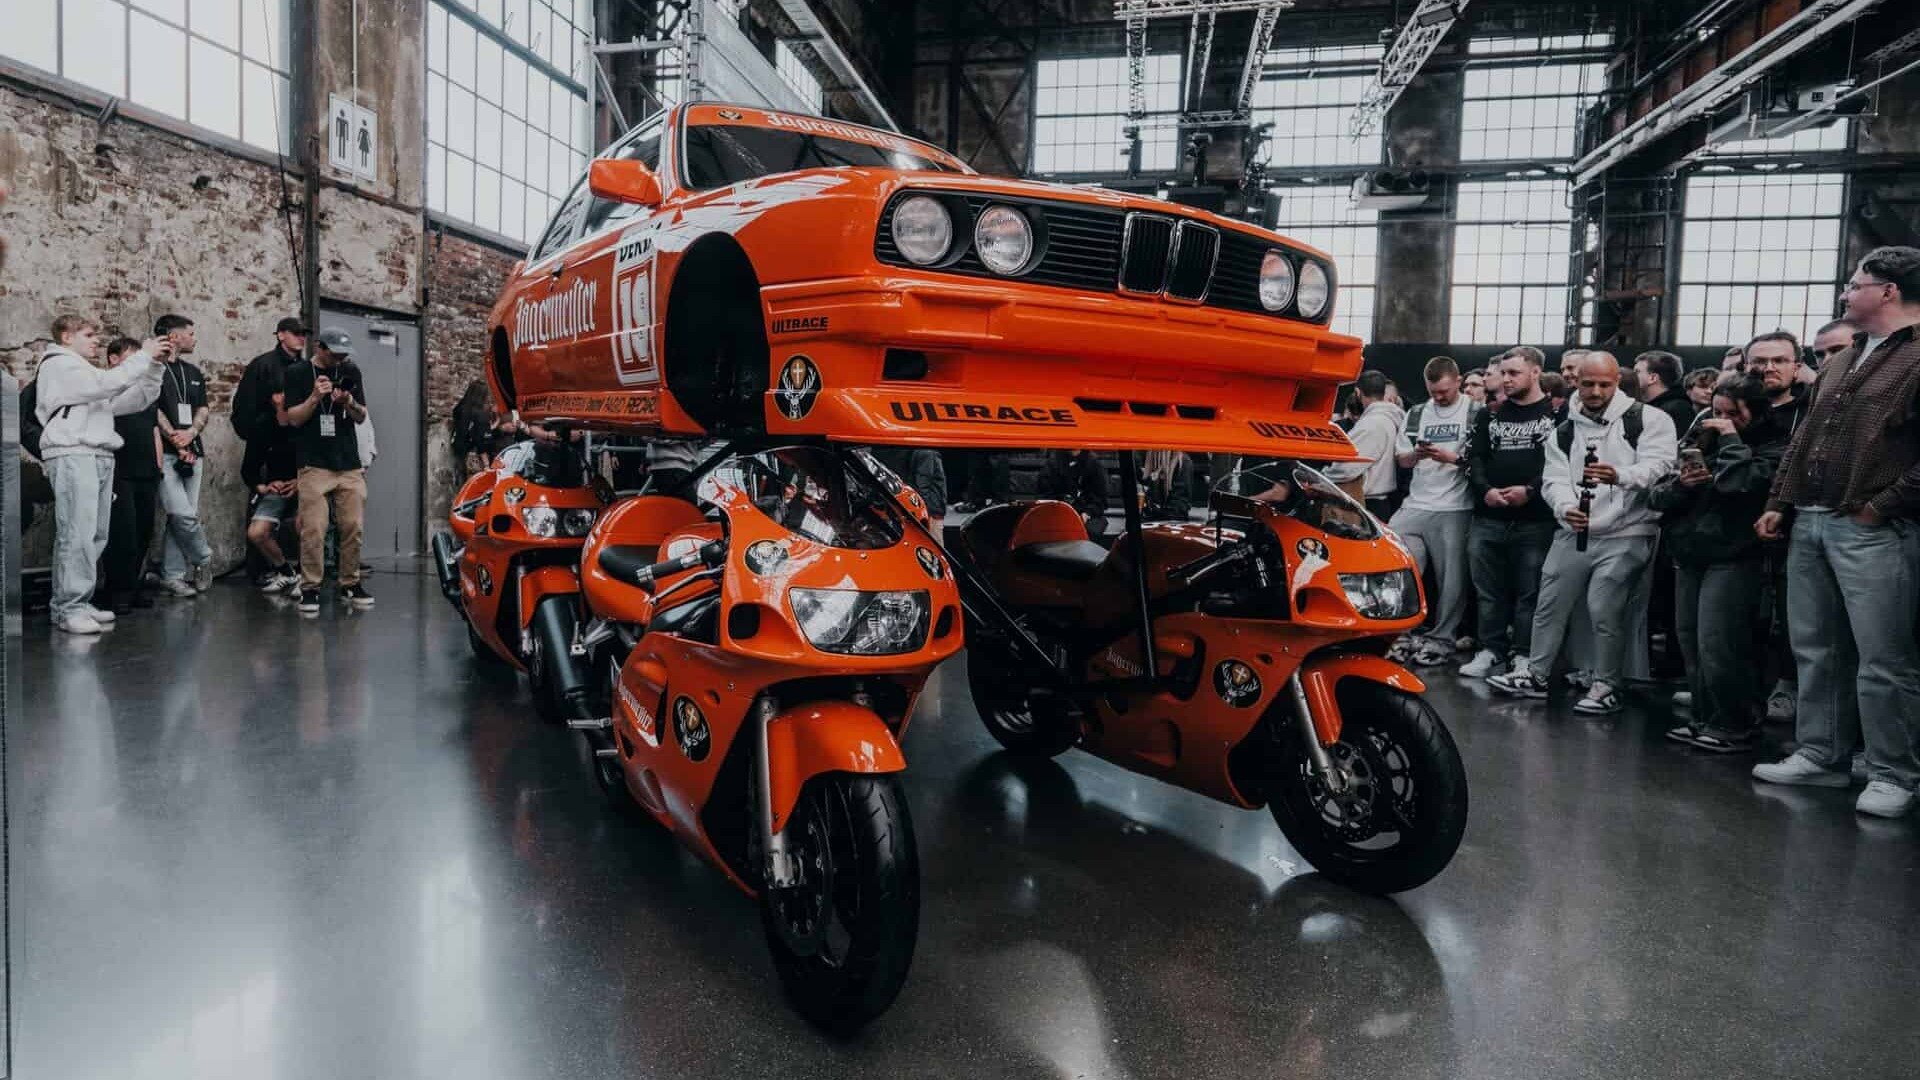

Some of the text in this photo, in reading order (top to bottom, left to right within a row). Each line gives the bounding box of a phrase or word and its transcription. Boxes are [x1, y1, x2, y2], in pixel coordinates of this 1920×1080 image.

[772, 317, 829, 334] ULTRACE
[890, 402, 1078, 427] ULTRACE
[1247, 421, 1351, 445] ULTRACE
